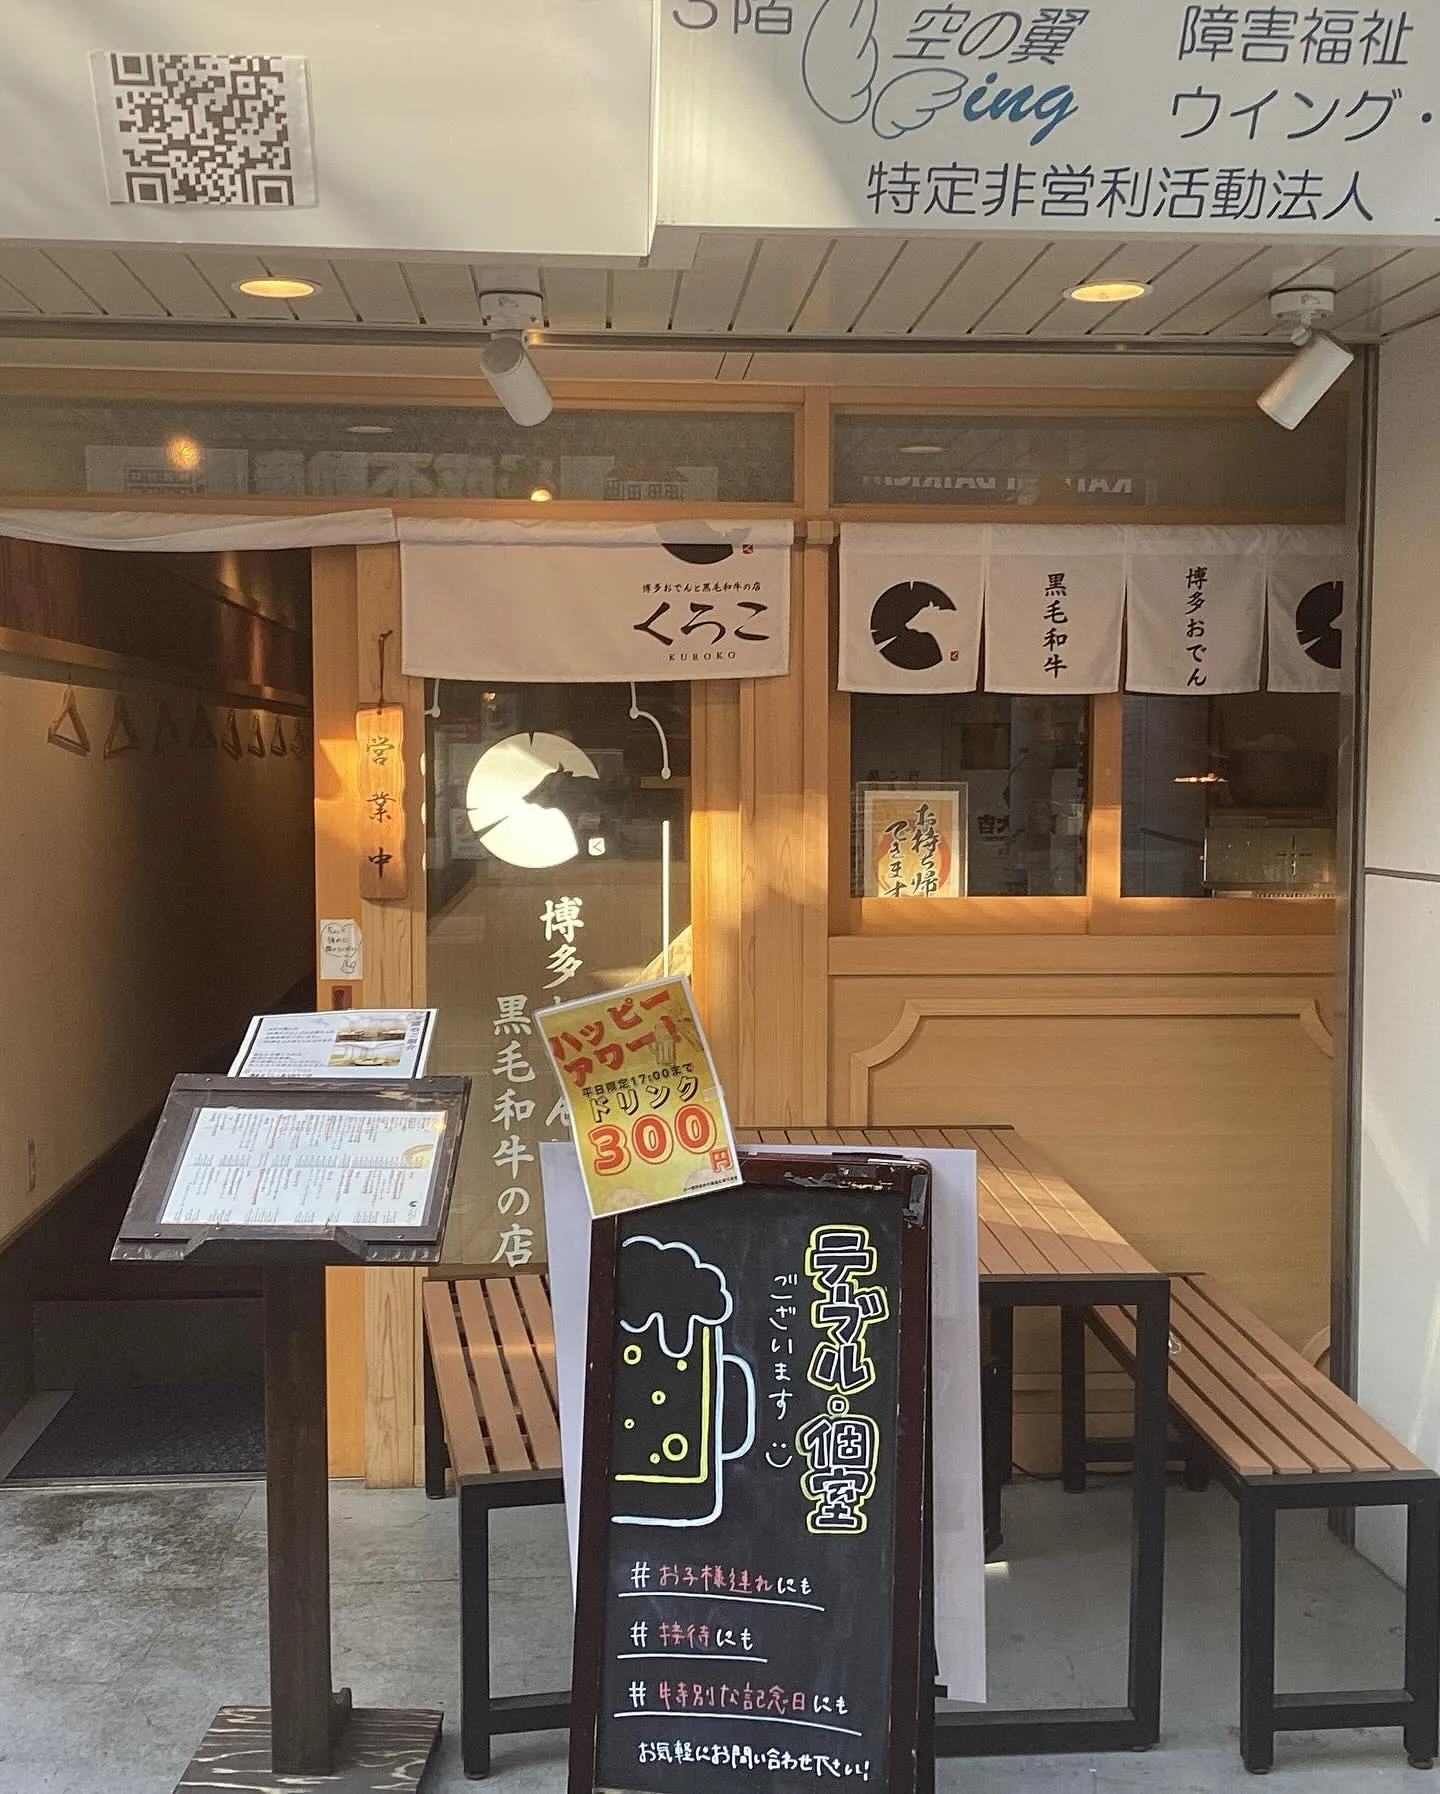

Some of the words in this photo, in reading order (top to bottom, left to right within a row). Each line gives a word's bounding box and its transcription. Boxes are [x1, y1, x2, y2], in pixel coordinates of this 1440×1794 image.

[892, 4, 1090, 66] 空の翼
[1179, 5, 1415, 66] 障害福祉
[867, 161, 1374, 223] 特定非営利活動法人
[642, 581, 761, 594] 博多おでんと黒毛和牛の店
[633, 601, 770, 646] くろこ
[1043, 572, 1070, 681] 黒毛和牛
[1183, 565, 1208, 689] 博多おでん
[668, 651, 736, 662] KUROKO
[366, 736, 397, 879] 営業中
[548, 990, 670, 1060] ハッピー
[582, 1062, 695, 1097] 平日限定17:00まで
[589, 1076, 698, 1123] ドリンク
[491, 994, 536, 1268] 黒毛和牛の店
[768, 1273, 798, 1420] ございます
[796, 1225, 890, 1534] テーブル・個室
